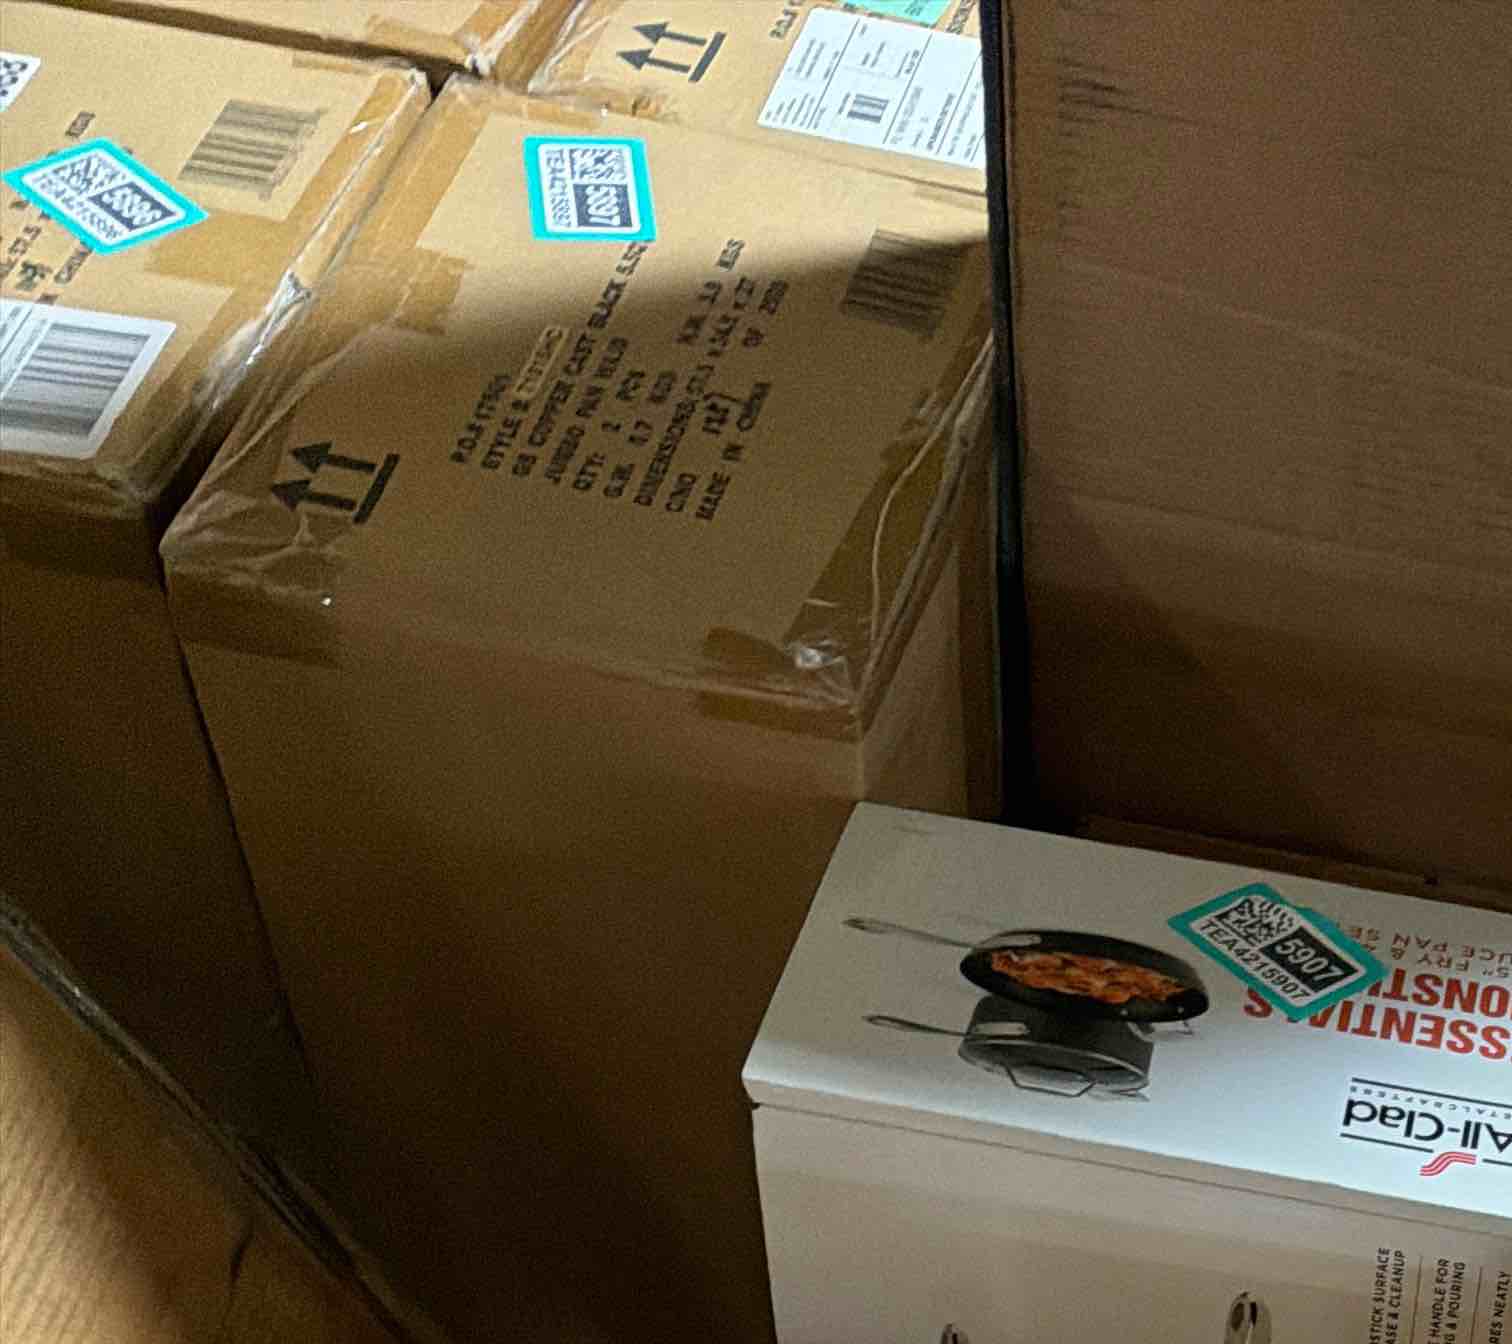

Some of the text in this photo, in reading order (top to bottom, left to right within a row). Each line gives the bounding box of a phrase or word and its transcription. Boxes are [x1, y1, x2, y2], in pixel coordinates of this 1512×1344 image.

[1199, 921, 1310, 1001] TEA4215907
[1275, 938, 1344, 982] 5907
[1393, 931, 1448, 953] PAN
[1417, 955, 1469, 974] FRY
[1373, 1247, 1392, 1304] SURFACE
[1388, 1249, 1407, 1310] CLEANUP
[1436, 1258, 1449, 1284] FOR
[1447, 1262, 1466, 1319] POURING
[1494, 1271, 1512, 1318] NEATLY
[1429, 1286, 1447, 1339] HANDLE
